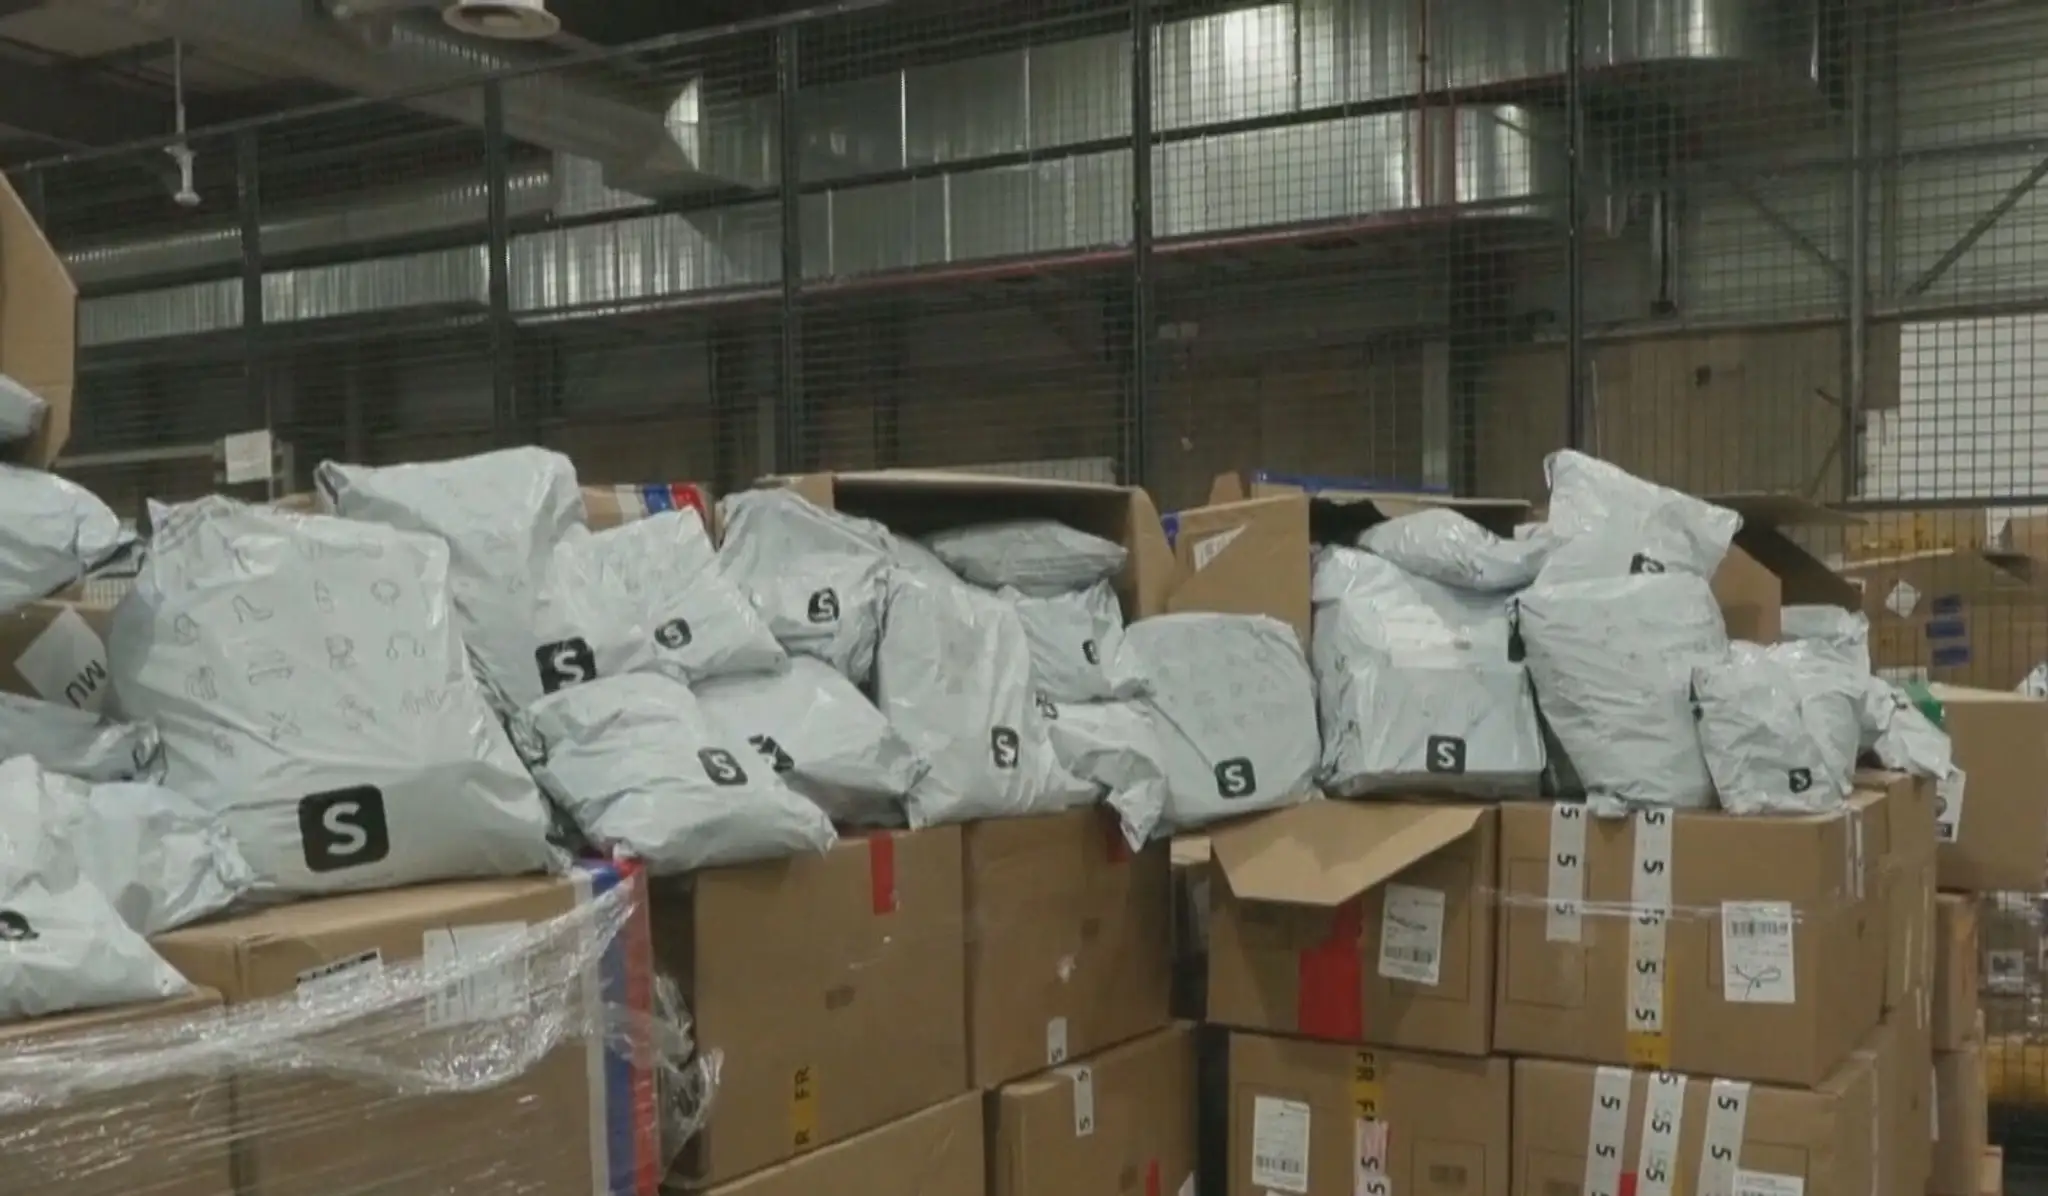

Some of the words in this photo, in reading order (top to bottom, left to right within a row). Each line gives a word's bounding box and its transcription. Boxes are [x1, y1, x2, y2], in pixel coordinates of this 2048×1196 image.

[553, 650, 585, 687] S
[711, 752, 737, 780] S
[1437, 740, 1456, 770] S
[1224, 764, 1247, 793] S
[322, 801, 368, 856] S
